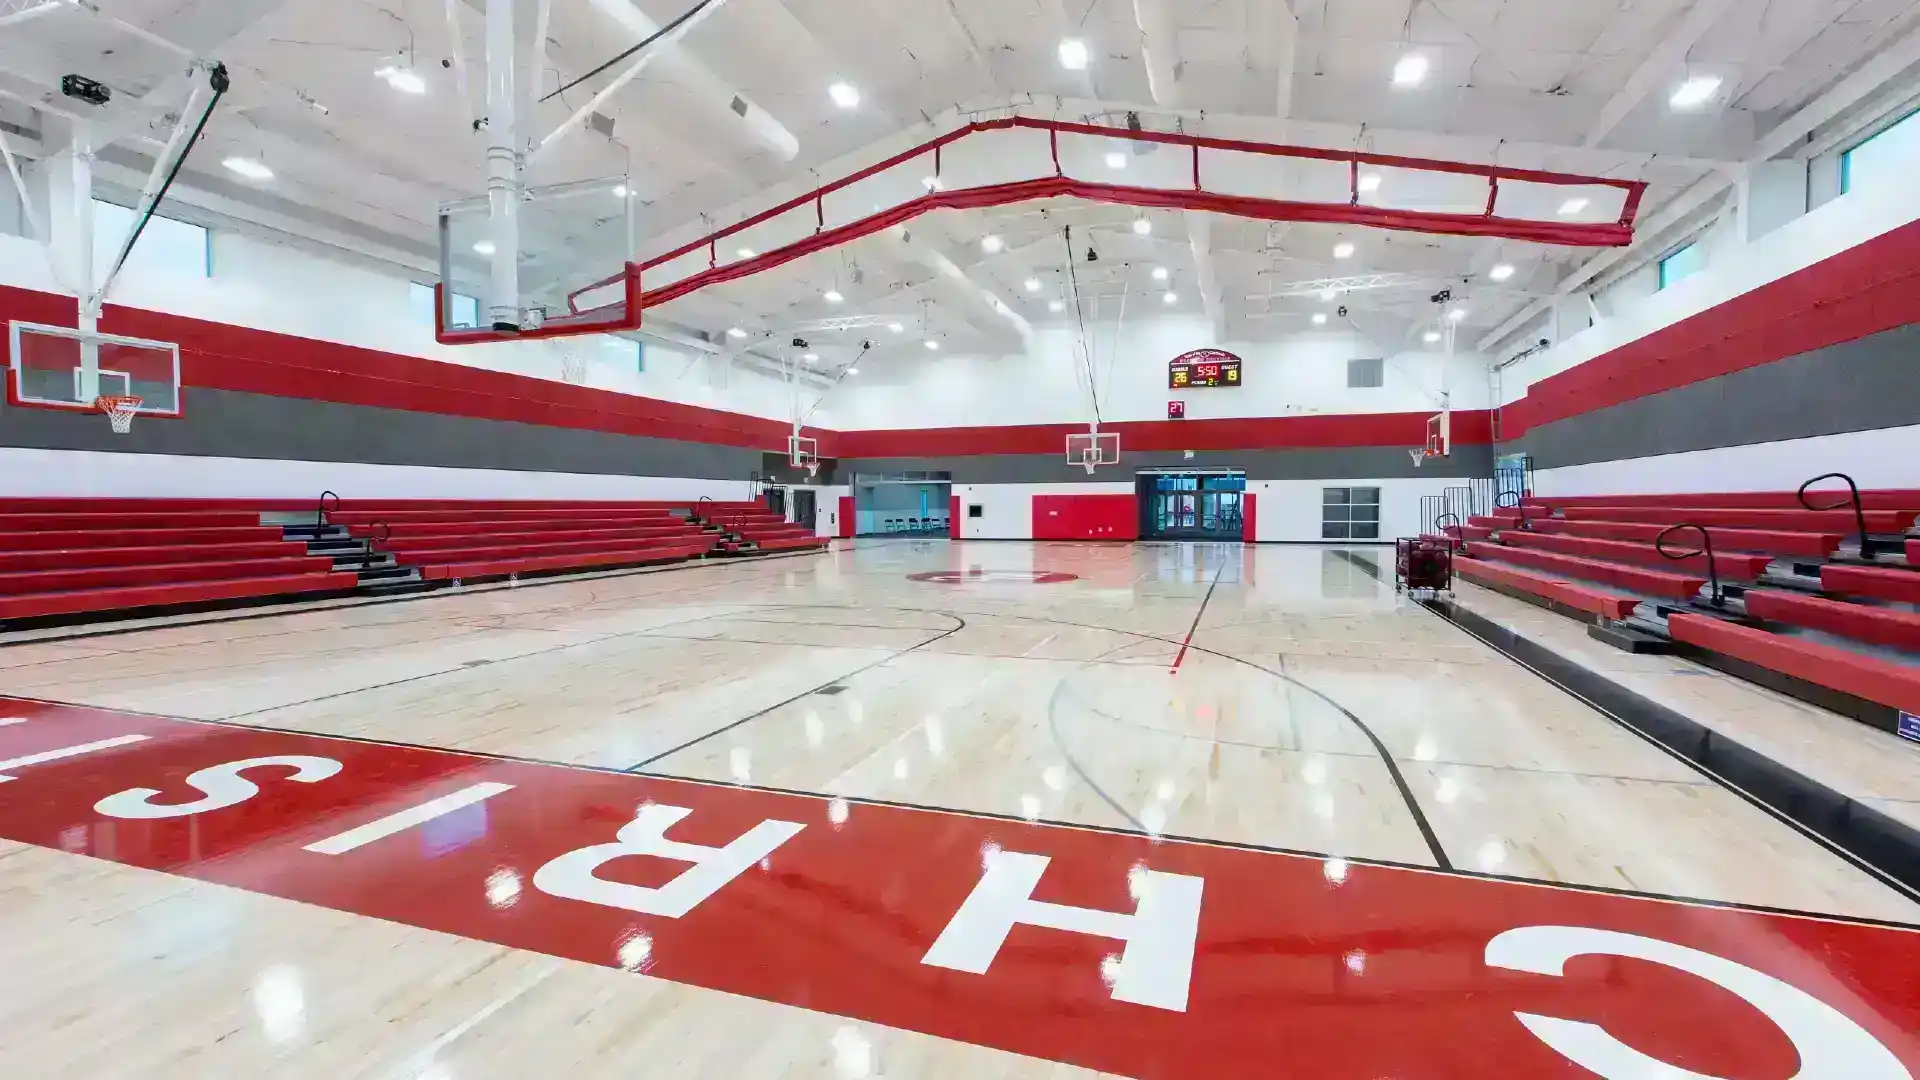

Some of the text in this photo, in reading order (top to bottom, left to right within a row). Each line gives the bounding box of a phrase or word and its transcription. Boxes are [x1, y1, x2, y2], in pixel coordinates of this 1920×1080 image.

[1198, 365, 1217, 376] 5:50
[1174, 372, 1187, 383] 26
[1208, 378, 1213, 386] 2
[1170, 402, 1183, 413] 27
